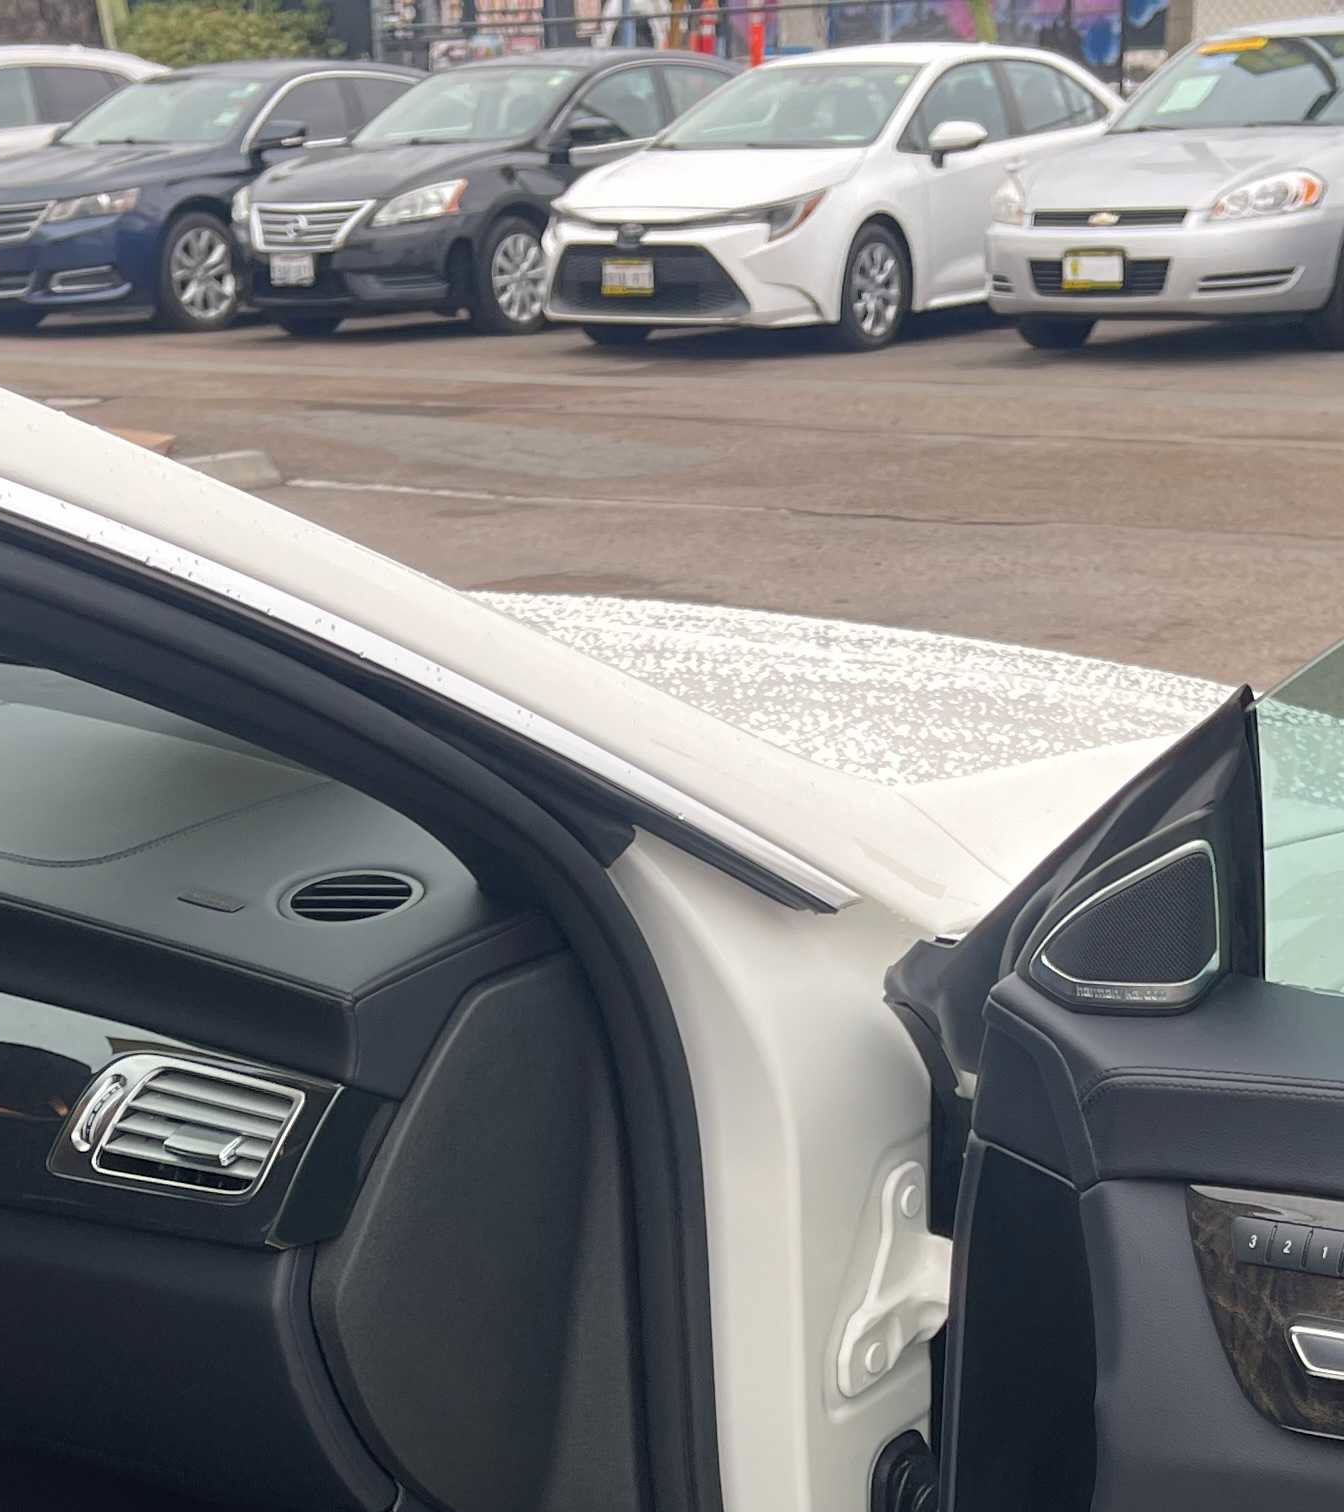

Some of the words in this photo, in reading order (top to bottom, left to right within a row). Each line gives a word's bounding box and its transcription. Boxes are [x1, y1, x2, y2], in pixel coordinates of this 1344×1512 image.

[1248, 1234, 1258, 1249] 3
[1282, 1239, 1293, 1254] 2
[1322, 1245, 1329, 1260] 1
